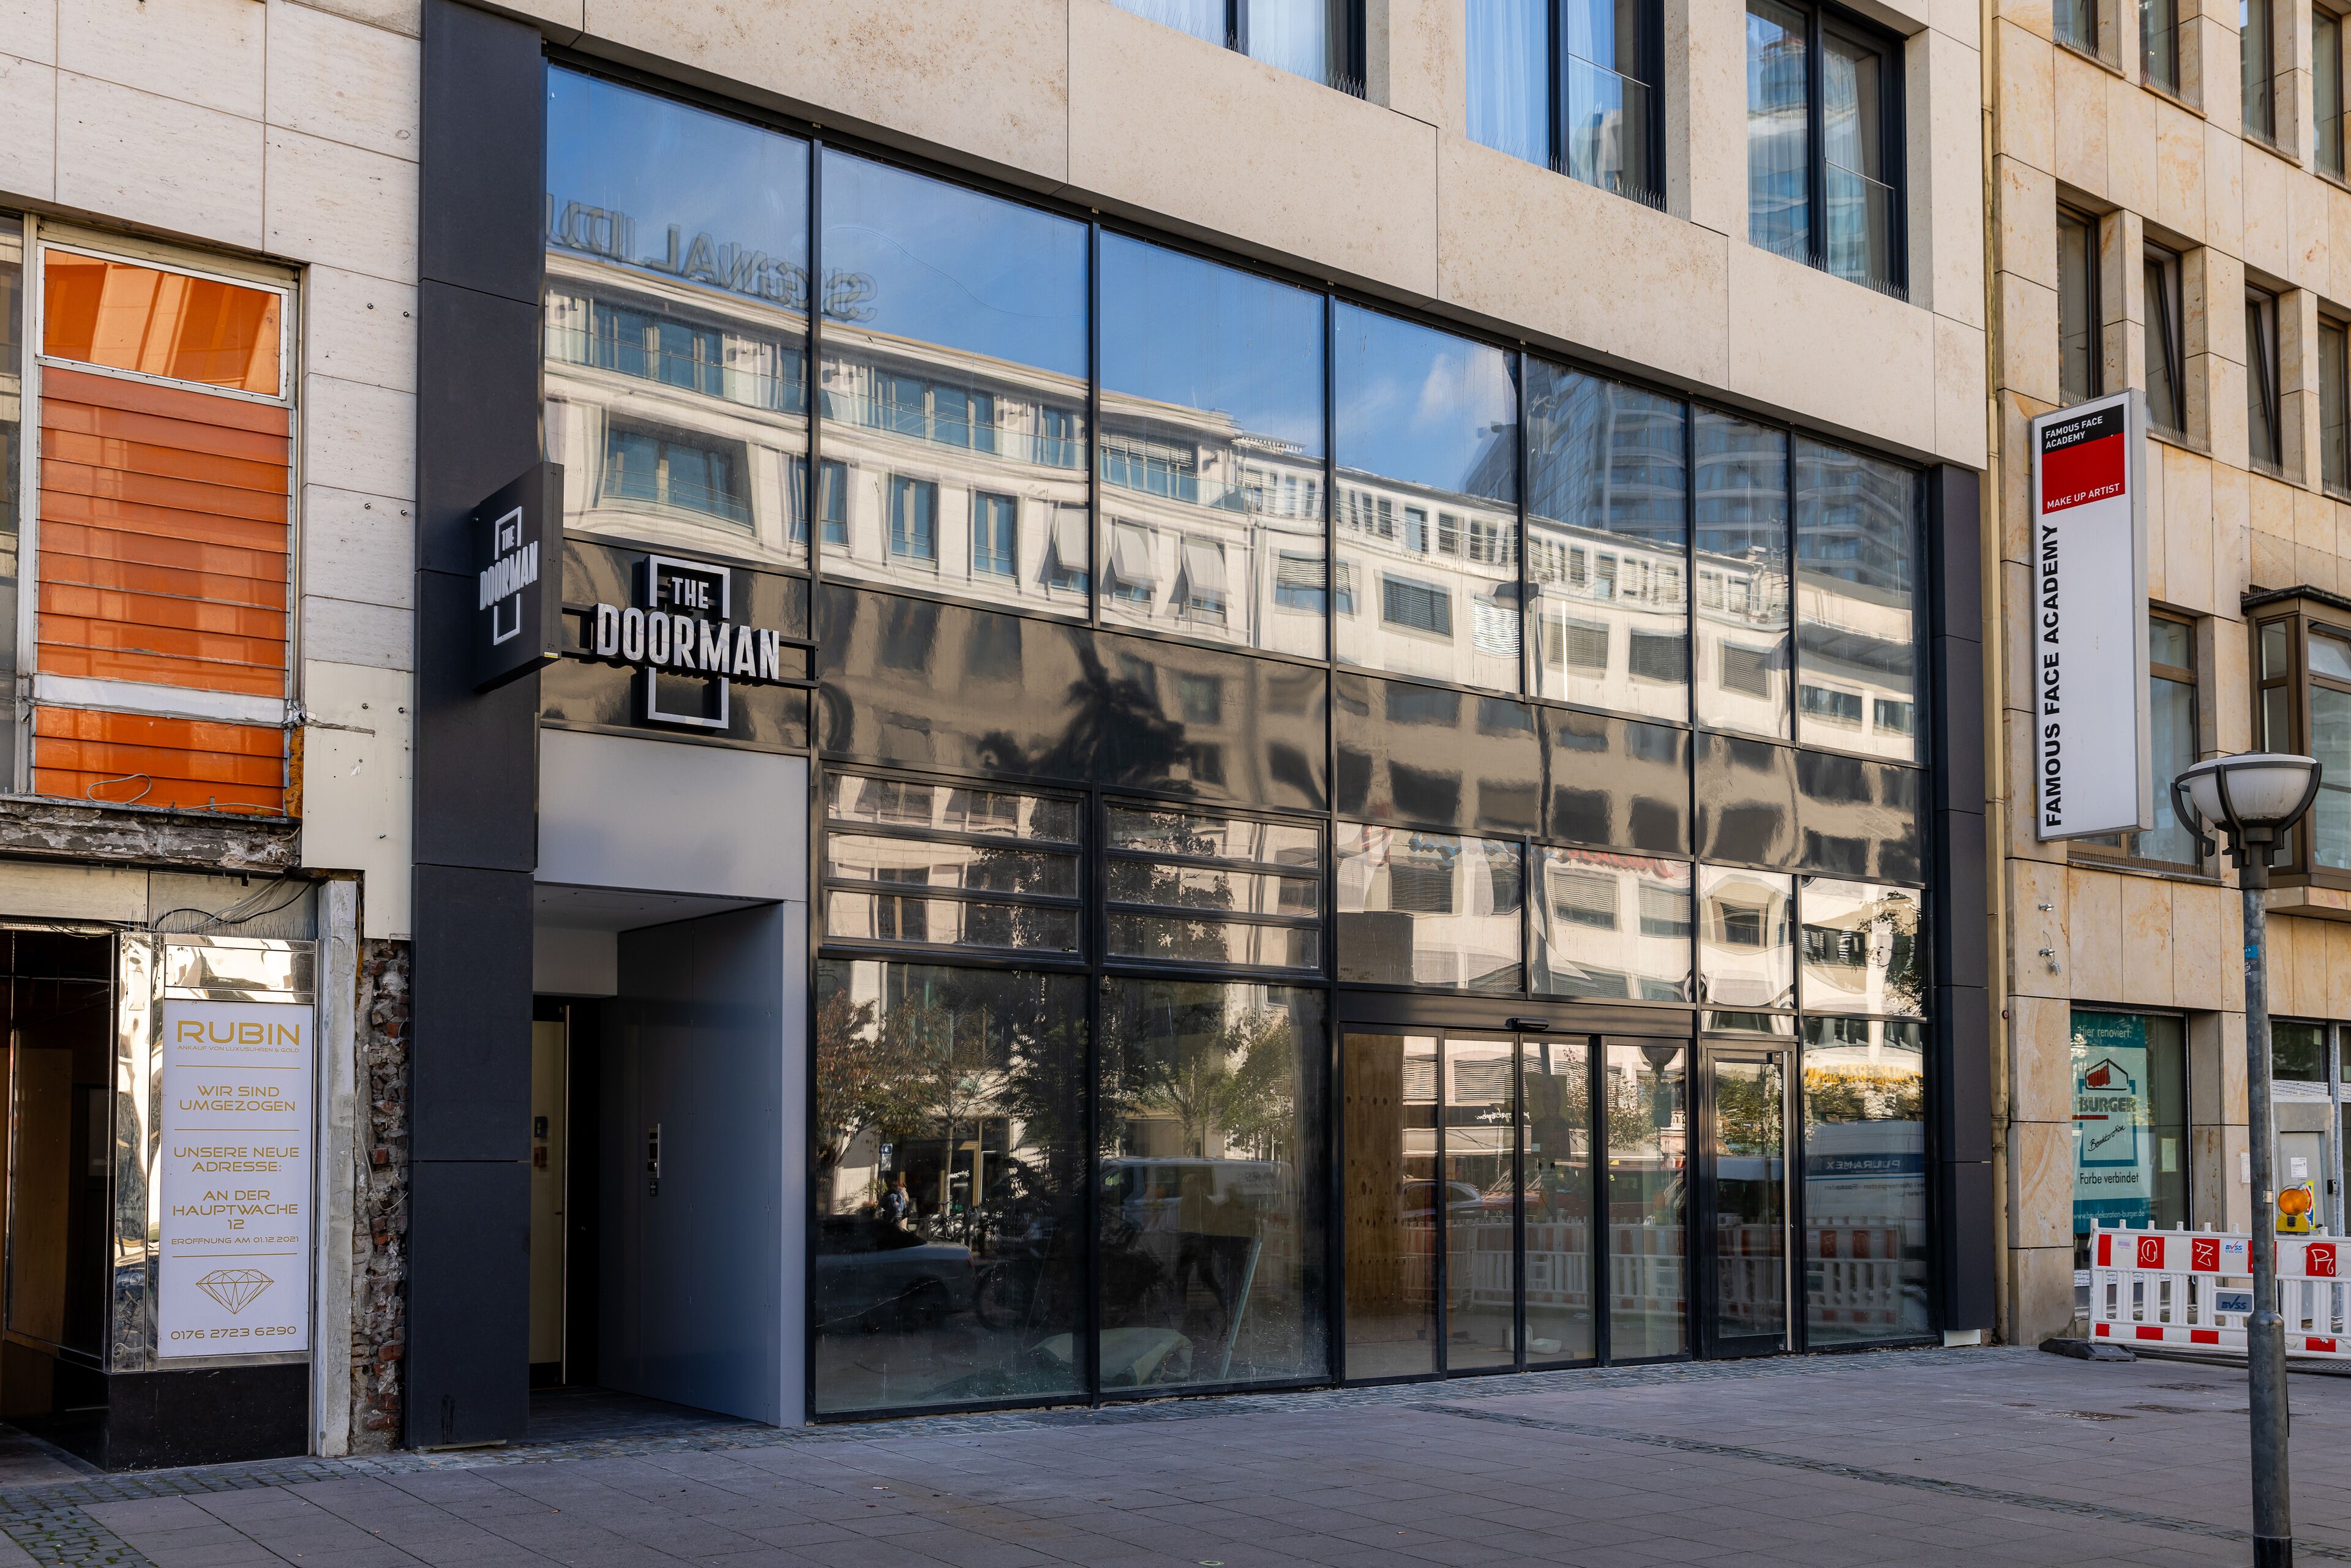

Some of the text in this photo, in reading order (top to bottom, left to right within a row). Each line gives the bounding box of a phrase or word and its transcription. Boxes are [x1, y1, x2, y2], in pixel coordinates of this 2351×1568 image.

[2045, 416, 2103, 439] FAMOUS FACE
[2045, 431, 2086, 449] ACADEMY
[2047, 482, 2120, 509] MAKE UP ARTIST
[501, 525, 515, 551] THE
[479, 540, 538, 610] DOORMAN
[671, 576, 709, 610] THE
[596, 602, 779, 680] DOORMAN
[2042, 525, 2061, 827] FAMOUS FACE ACADEMY
[177, 1020, 300, 1046] RUBIN
[2079, 1025, 2132, 1038] Hier renoviert:
[197, 1085, 280, 1097] WIR SIND
[179, 1100, 296, 1112] UMGEZOGEN
[2079, 1097, 2136, 1112] BURGER
[174, 1147, 299, 1158] UNSERE NEUE
[192, 1161, 282, 1172] ADRESSE:
[2080, 1171, 2139, 1184] Farbe verbindet
[203, 1190, 271, 1201] AN DER
[173, 1204, 298, 1215] HAUPTWACHE
[227, 1218, 245, 1229] 12
[2225, 1241, 2243, 1250] BVSS
[2221, 1296, 2246, 1310] BVSS
[170, 1326, 296, 1340] 0176 2723 6290
